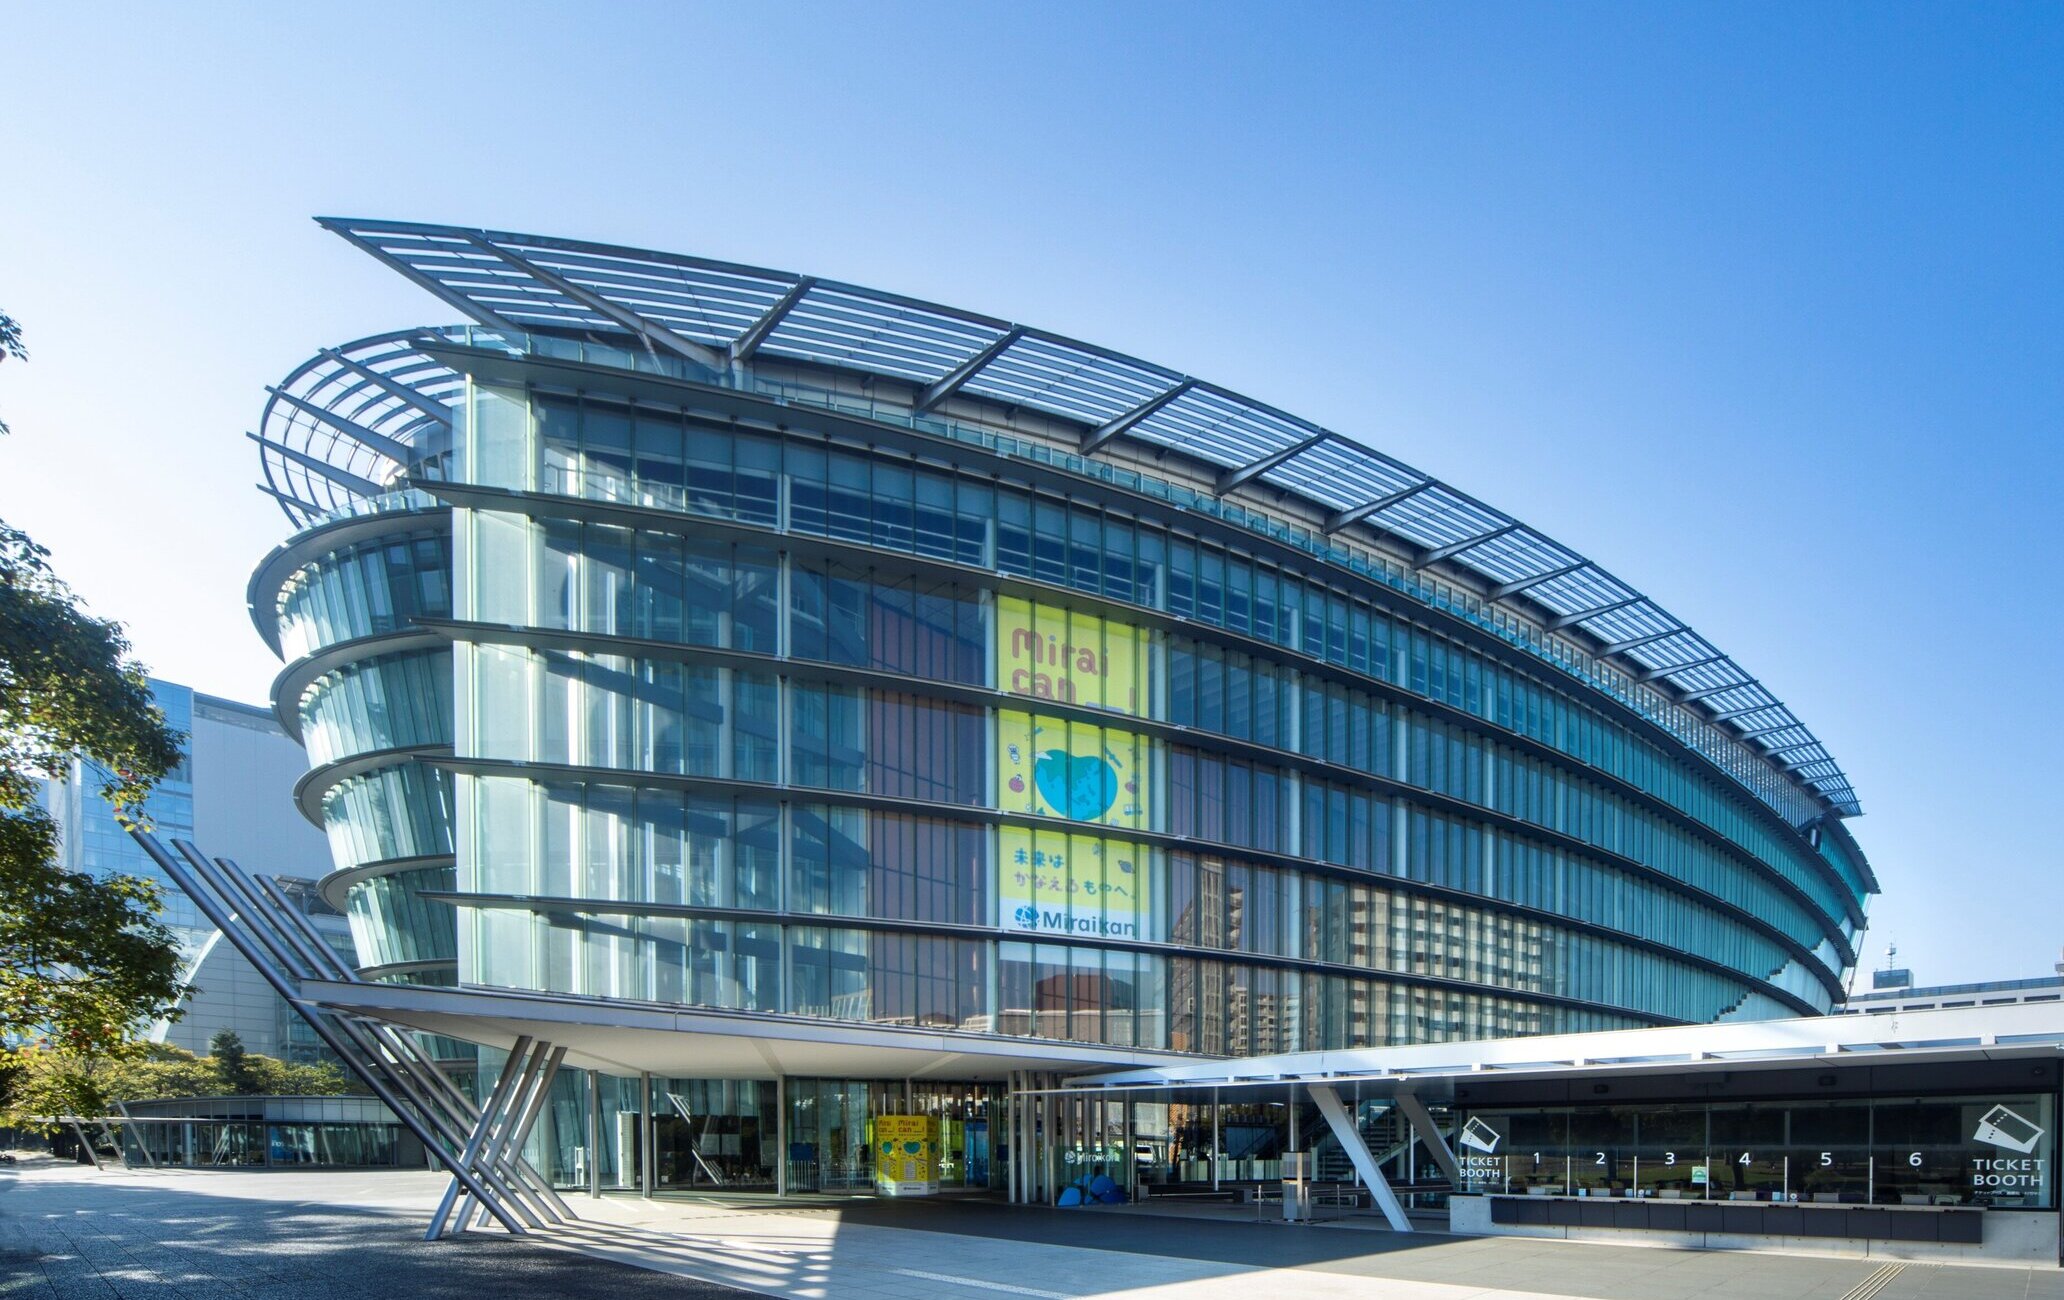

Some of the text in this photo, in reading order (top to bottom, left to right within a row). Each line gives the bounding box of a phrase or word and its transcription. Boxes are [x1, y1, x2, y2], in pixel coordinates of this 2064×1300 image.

[1014, 848, 1064, 869] 未来は
[1043, 911, 1137, 936] Miraikan
[1459, 1156, 1500, 1166] TICKET
[1533, 1152, 1540, 1164] 1
[1595, 1152, 1606, 1165] 2
[1664, 1152, 1675, 1165] 3
[1738, 1152, 1751, 1167] 4
[1820, 1152, 1832, 1166] 5
[1908, 1152, 1922, 1167] 6
[1972, 1158, 2046, 1171] TICKET
[1459, 1168, 1500, 1178] BOOTH
[1973, 1174, 2044, 1187] BOOTH
